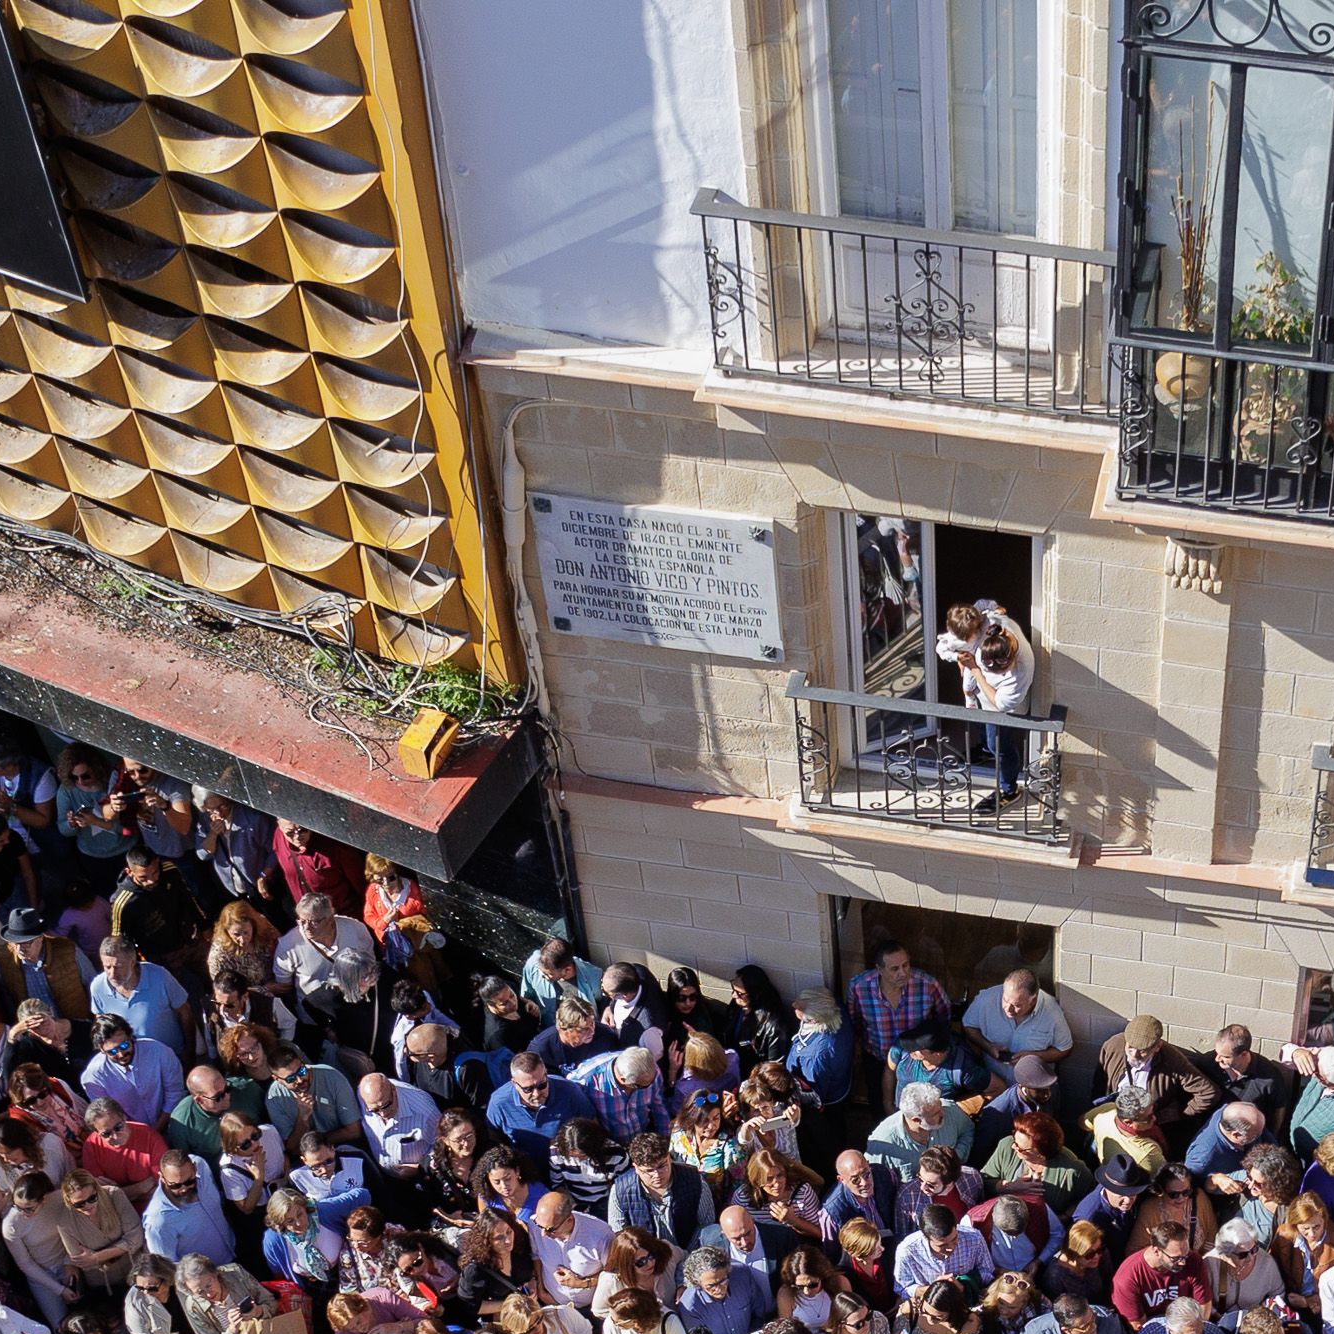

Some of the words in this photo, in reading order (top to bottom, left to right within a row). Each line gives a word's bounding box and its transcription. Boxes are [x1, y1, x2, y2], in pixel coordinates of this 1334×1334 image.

[561, 522, 618, 539] DICIEMBRE
[623, 530, 636, 540] DE
[688, 538, 743, 554] EMINENTE
[569, 510, 584, 522] EN
[588, 513, 615, 526] ESTA
[619, 516, 647, 529] CASA
[651, 520, 683, 534] NACIÓ
[688, 525, 701, 536] EL
[706, 527, 713, 537] 3
[717, 529, 731, 540] DE
[574, 536, 609, 551] ACTOR
[677, 548, 715, 563] GLORIA
[719, 554, 733, 566] DE
[595, 551, 609, 563] LA
[613, 554, 655, 569] ESCENA
[555, 558, 585, 577] DON
[590, 565, 649, 586] ANTONIO
[654, 572, 688, 591] VICO
[695, 576, 701, 592] Y
[553, 580, 578, 593] PARA
[581, 584, 620, 599] HONRAR
[622, 590, 635, 600] SU
[637, 592, 680, 607] MEMORIA
[724, 602, 735, 613] EL
[562, 594, 633, 612] AYUNTAMIENTO
[636, 604, 649, 614] EN
[689, 610, 701, 621] DE
[705, 612, 710, 621] 7
[714, 613, 726, 624] DE
[729, 615, 762, 627] MARZO
[568, 606, 580, 616] DE
[684, 621, 695, 632] DE
[699, 623, 722, 634] ESTA
[1144, 1286, 1179, 1307] VANS
